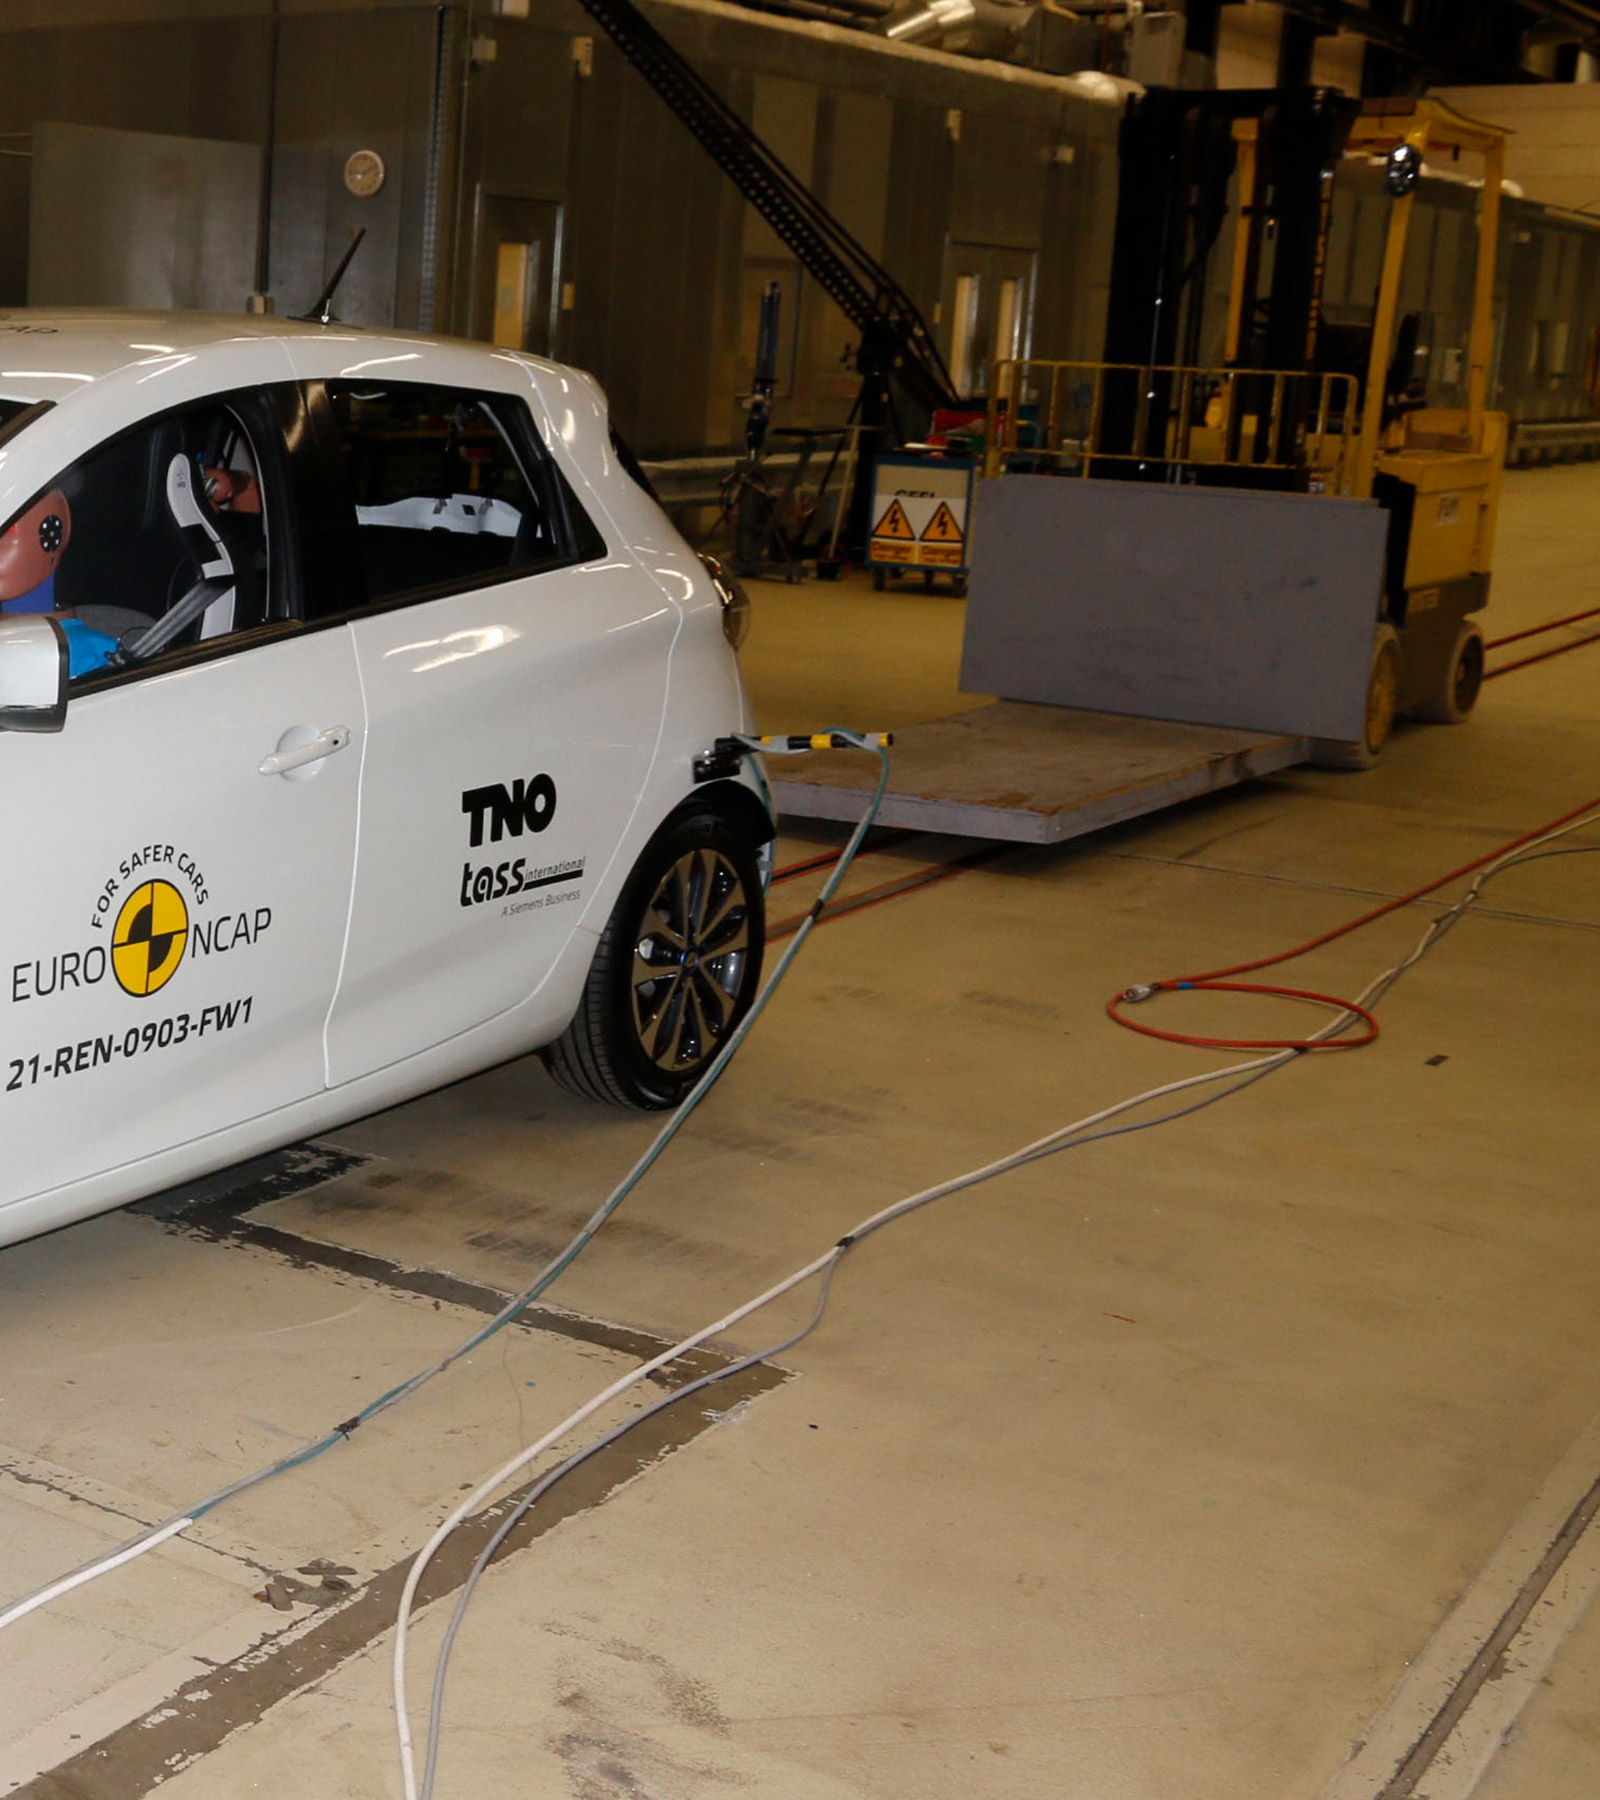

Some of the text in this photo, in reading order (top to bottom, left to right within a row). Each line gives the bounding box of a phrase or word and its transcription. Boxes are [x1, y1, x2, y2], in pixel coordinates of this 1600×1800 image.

[461, 773, 557, 848] TNO
[91, 844, 209, 929] FOR SAFER CARS
[460, 856, 587, 907] tass international
[501, 889, 582, 918] A Siemens Business
[12, 907, 272, 1002] EURO NCAP
[6, 996, 253, 1092] 21-REN-0903-FW1
